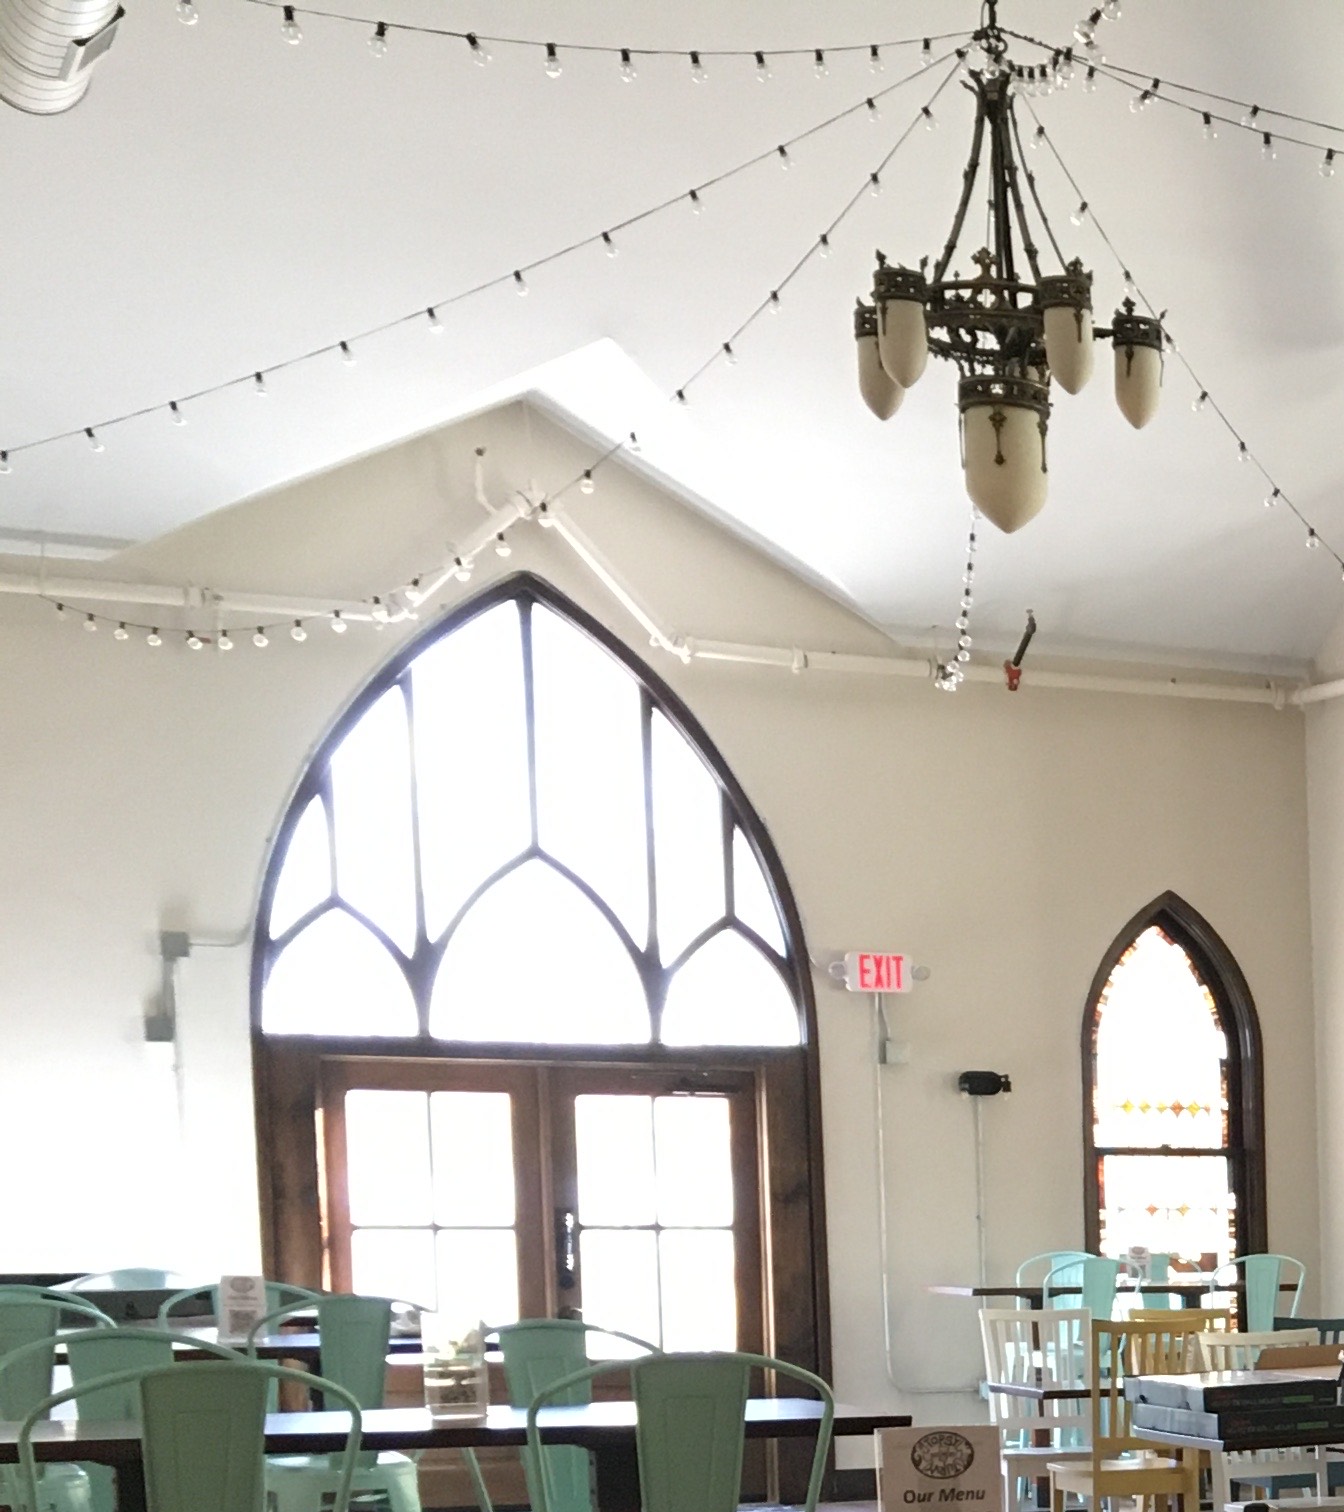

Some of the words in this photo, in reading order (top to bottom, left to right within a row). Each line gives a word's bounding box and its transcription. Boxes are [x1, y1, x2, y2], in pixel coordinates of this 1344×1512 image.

[859, 954, 903, 989] EXIT
[924, 1434, 961, 1449] TOPSY
[903, 1489, 933, 1504] Our
[938, 1487, 986, 1502] Menu
